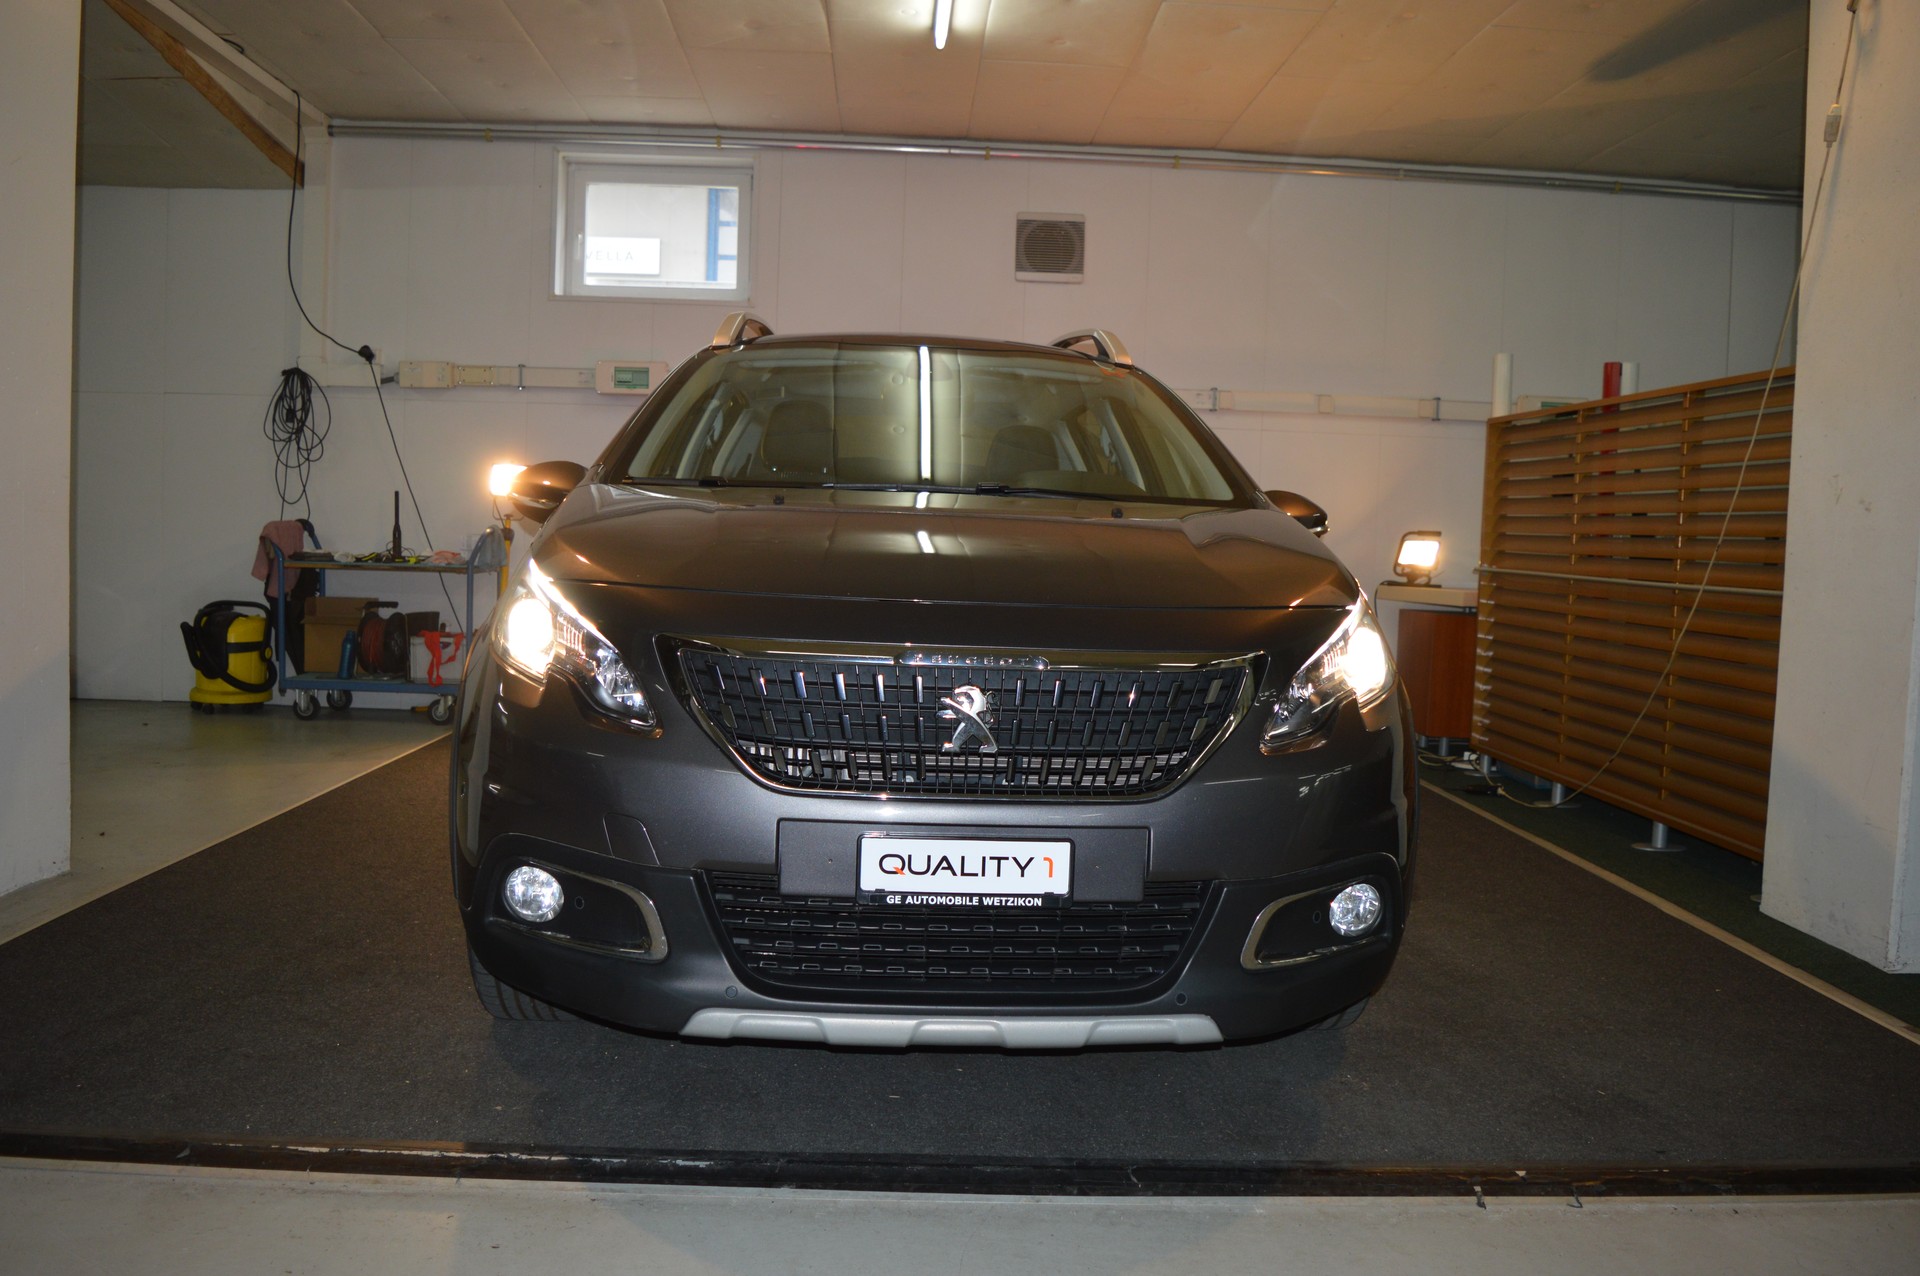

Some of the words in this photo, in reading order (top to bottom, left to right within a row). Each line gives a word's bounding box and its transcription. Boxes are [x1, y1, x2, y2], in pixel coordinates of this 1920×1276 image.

[913, 653, 1030, 666] PEUGEOT
[878, 853, 1035, 878] QUALITY
[1043, 856, 1054, 878] 1
[886, 895, 902, 905] GE
[905, 895, 979, 906] AUTOMOBILE
[982, 897, 1043, 907] WETZIKON
